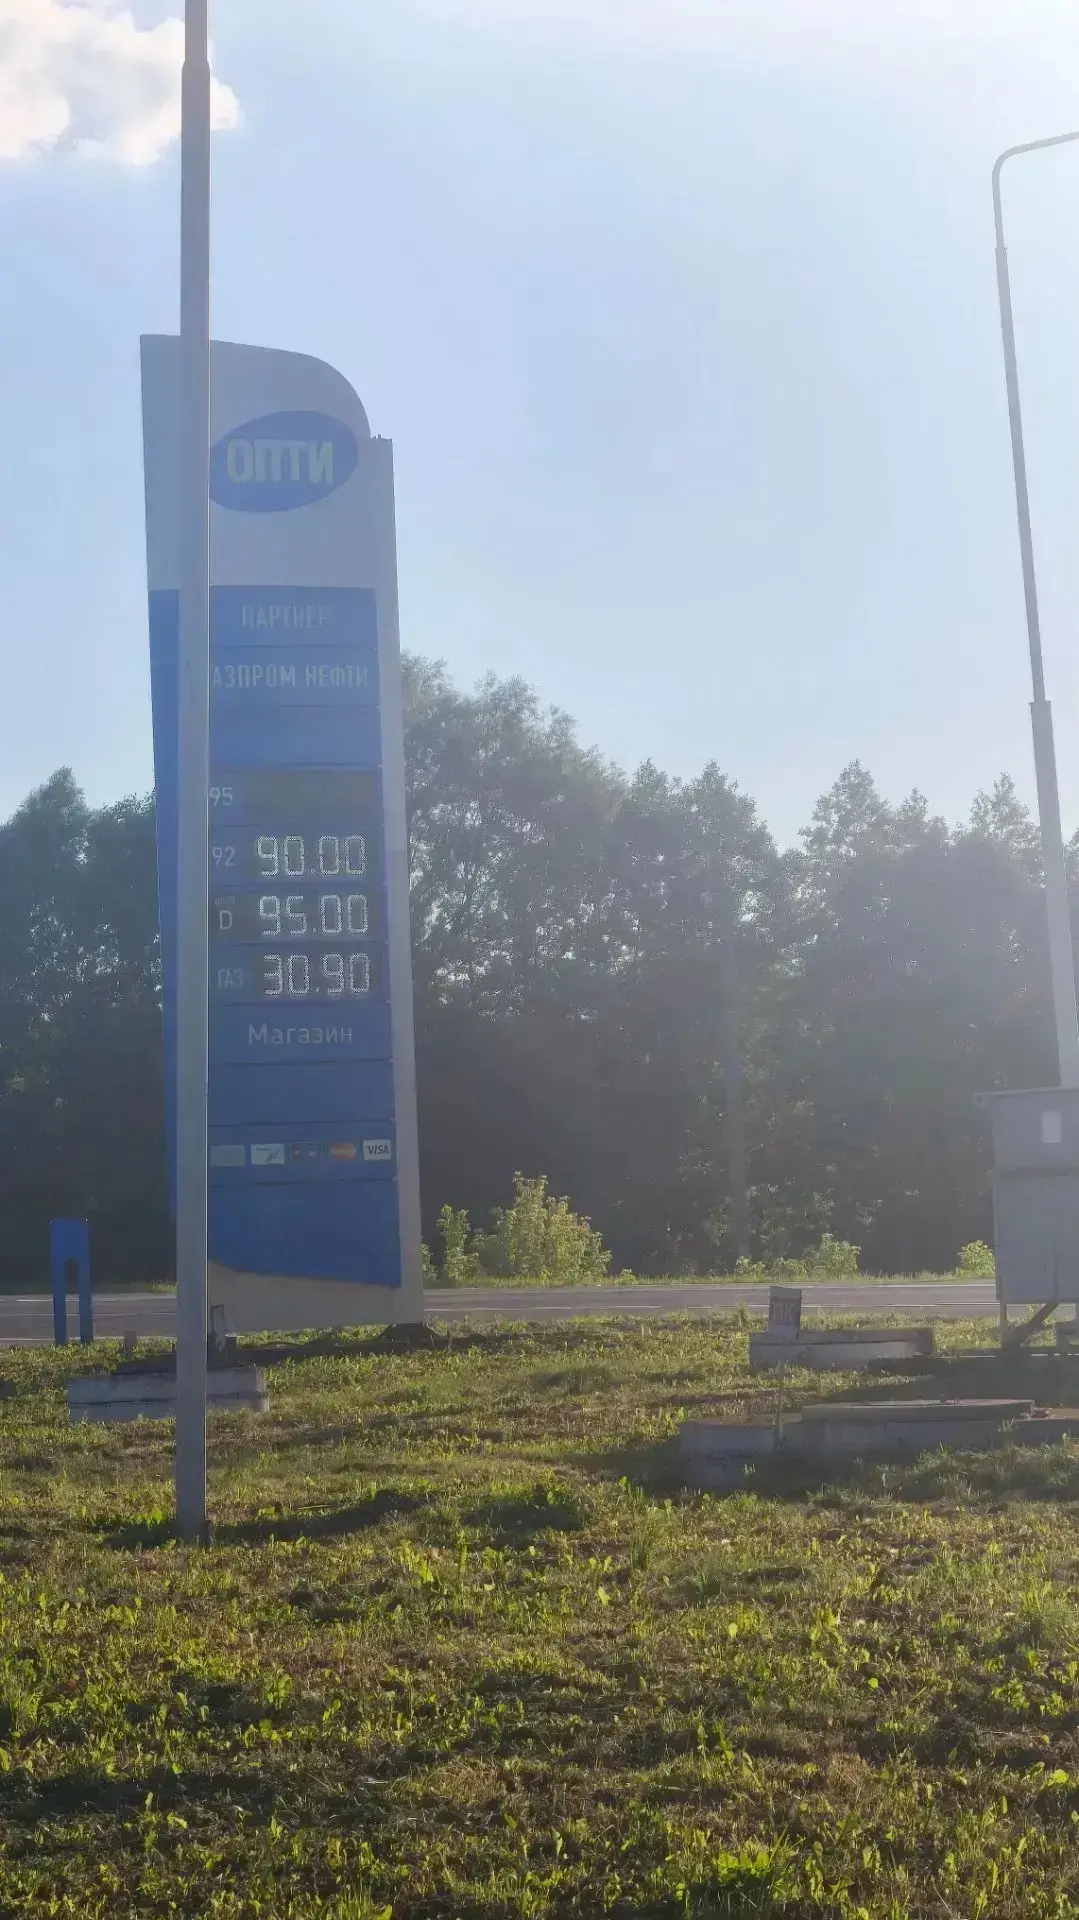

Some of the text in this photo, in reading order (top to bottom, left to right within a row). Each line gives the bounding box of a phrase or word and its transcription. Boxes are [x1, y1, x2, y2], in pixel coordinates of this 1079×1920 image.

[227, 438, 334, 484] ОПТИ
[211, 664, 368, 689] АЗПРОМ НЕФТИ
[209, 786, 234, 807] 95
[212, 835, 367, 877] 92 90.00
[219, 894, 369, 936] D 95.00
[217, 952, 371, 995] ГАЗ 30.90
[247, 1023, 353, 1046] Магазин
[366, 1144, 390, 1155] VISA
